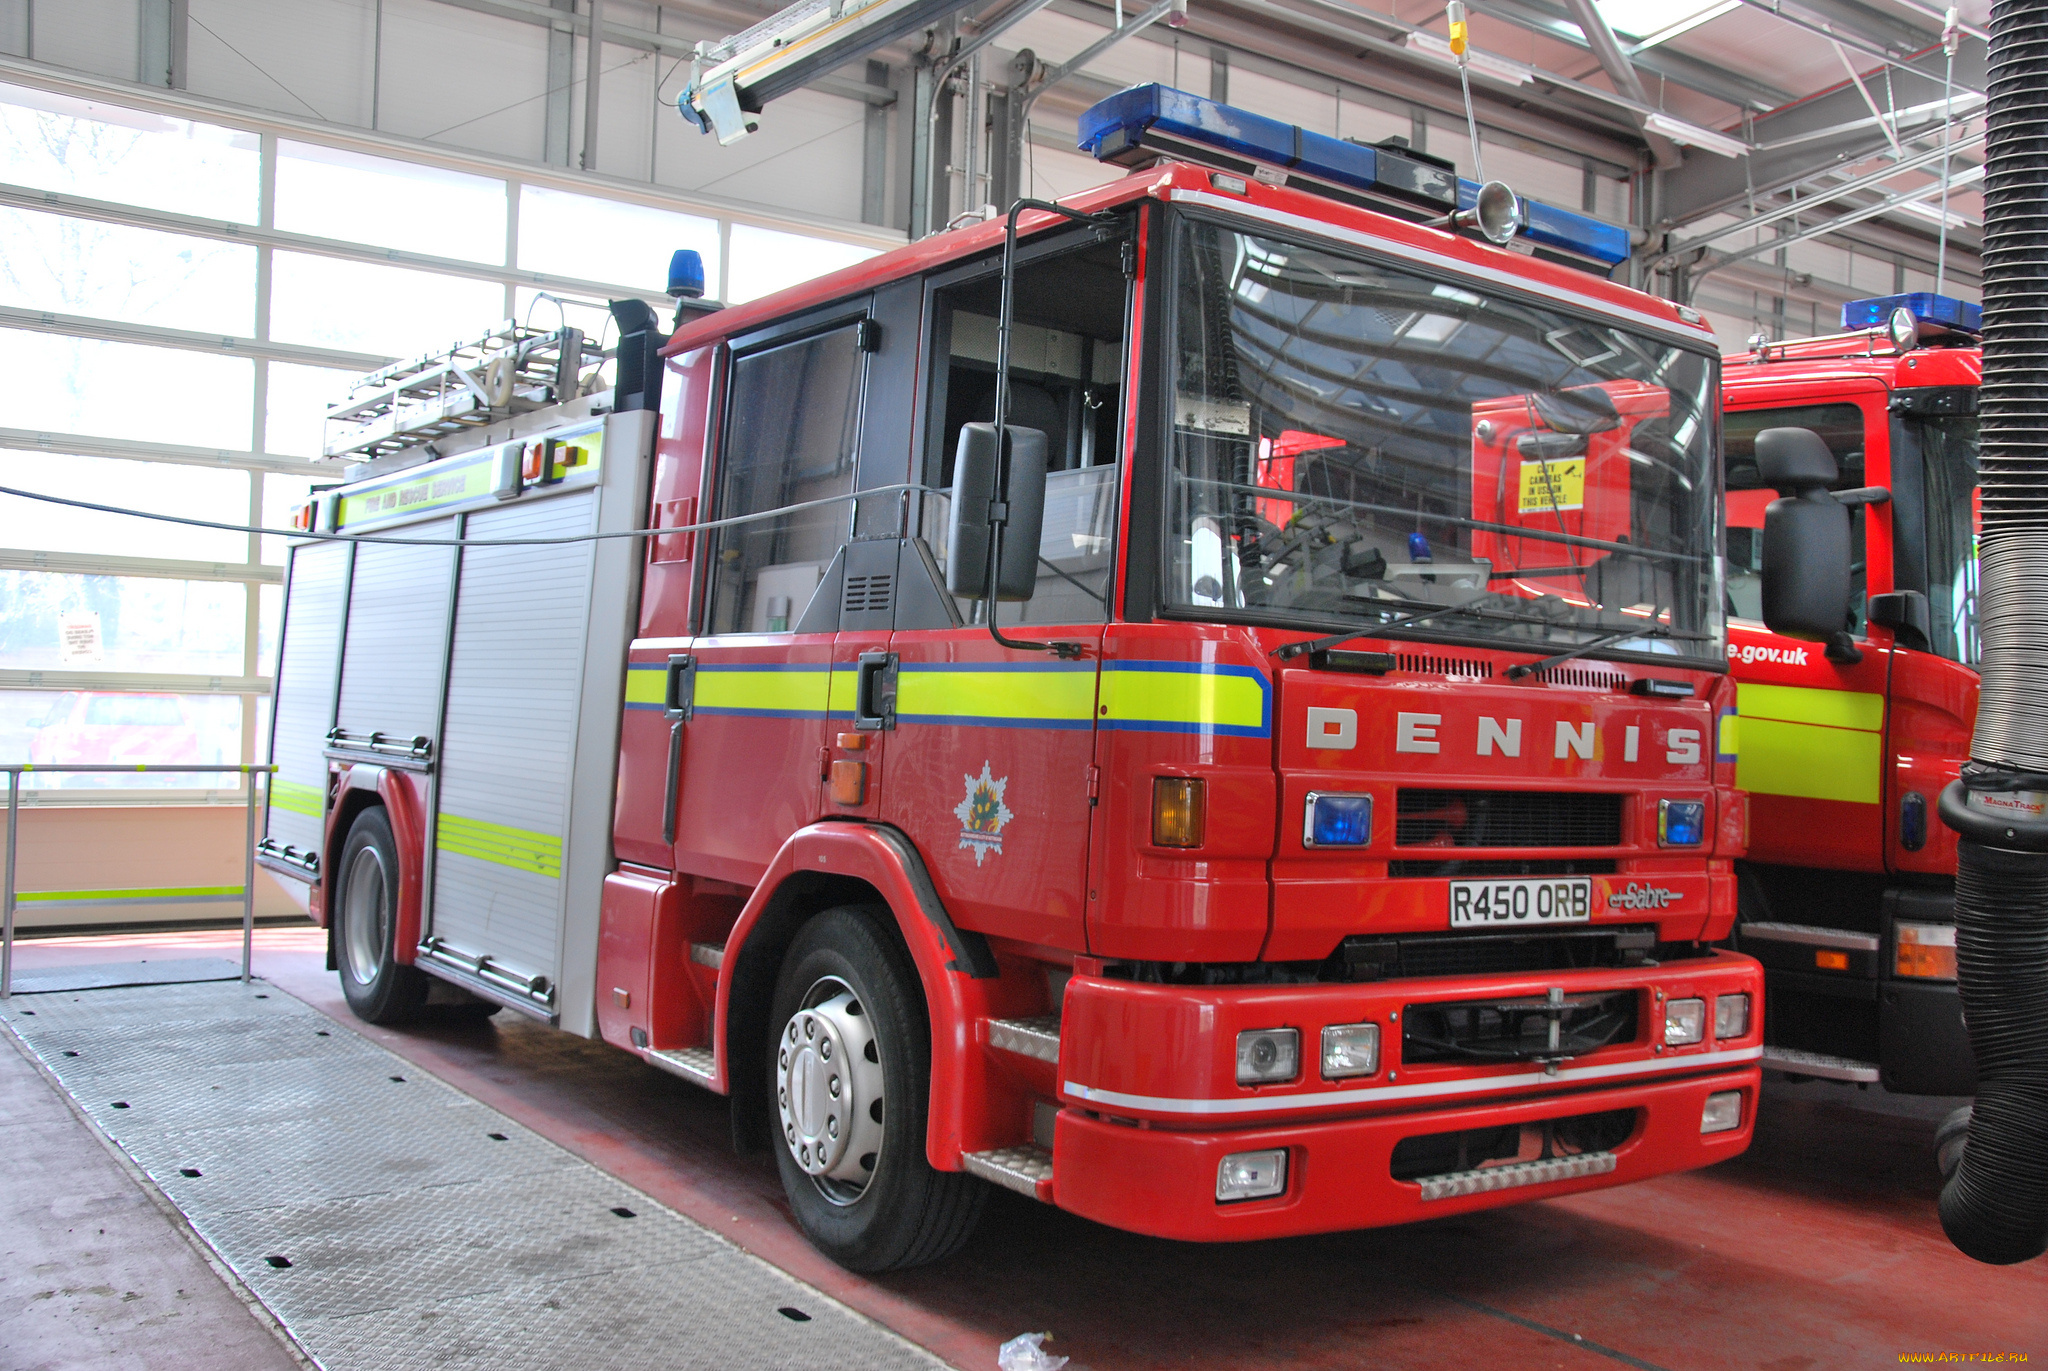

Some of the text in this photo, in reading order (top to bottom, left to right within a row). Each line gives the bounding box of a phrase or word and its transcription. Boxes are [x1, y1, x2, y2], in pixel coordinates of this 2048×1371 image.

[1538, 464, 1555, 474] CTV
[1530, 474, 1562, 485] CAMRAS
[1523, 495, 1566, 506] THIS VEHCLE
[1306, 706, 1701, 764] DENNIS
[1454, 883, 1588, 921] R450 ORB
[1624, 882, 1671, 909] Sabre
